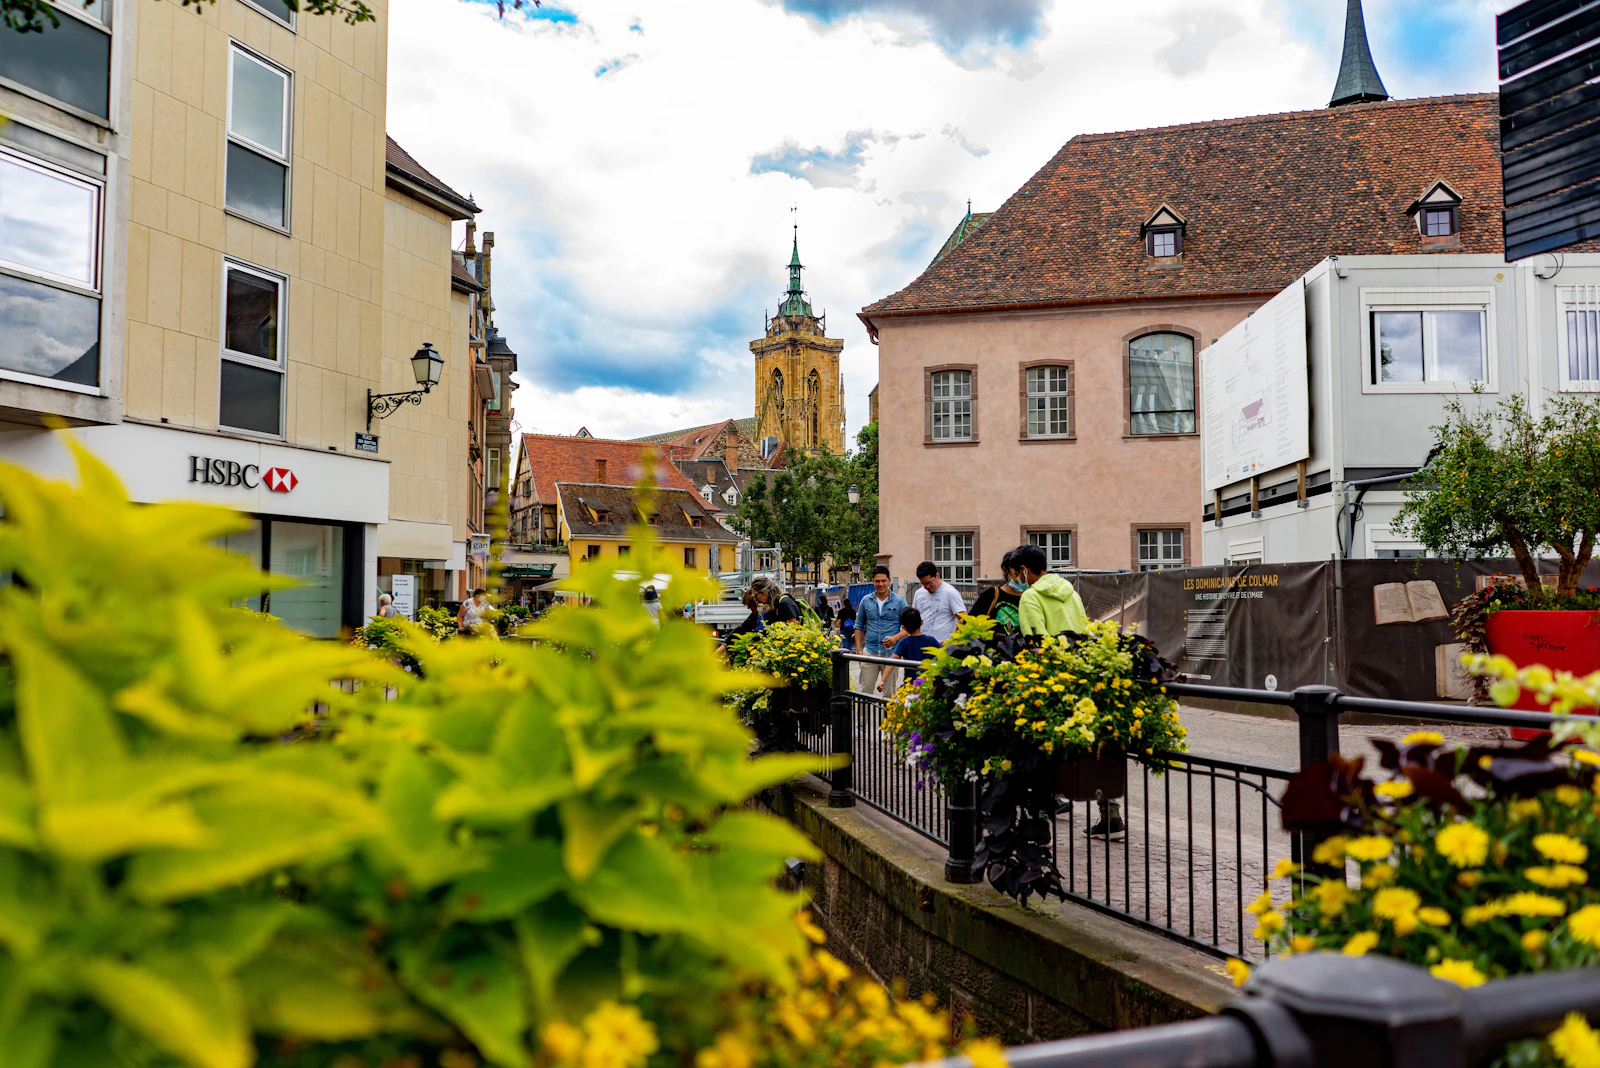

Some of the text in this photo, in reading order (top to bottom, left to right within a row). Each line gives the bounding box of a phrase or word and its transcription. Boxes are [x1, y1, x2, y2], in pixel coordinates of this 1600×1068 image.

[188, 455, 260, 489] HSBC
[472, 542, 488, 550] gan
[1184, 574, 1278, 590] LES DOMINICAINS DE COLMAR
[1240, 591, 1247, 599] DE
